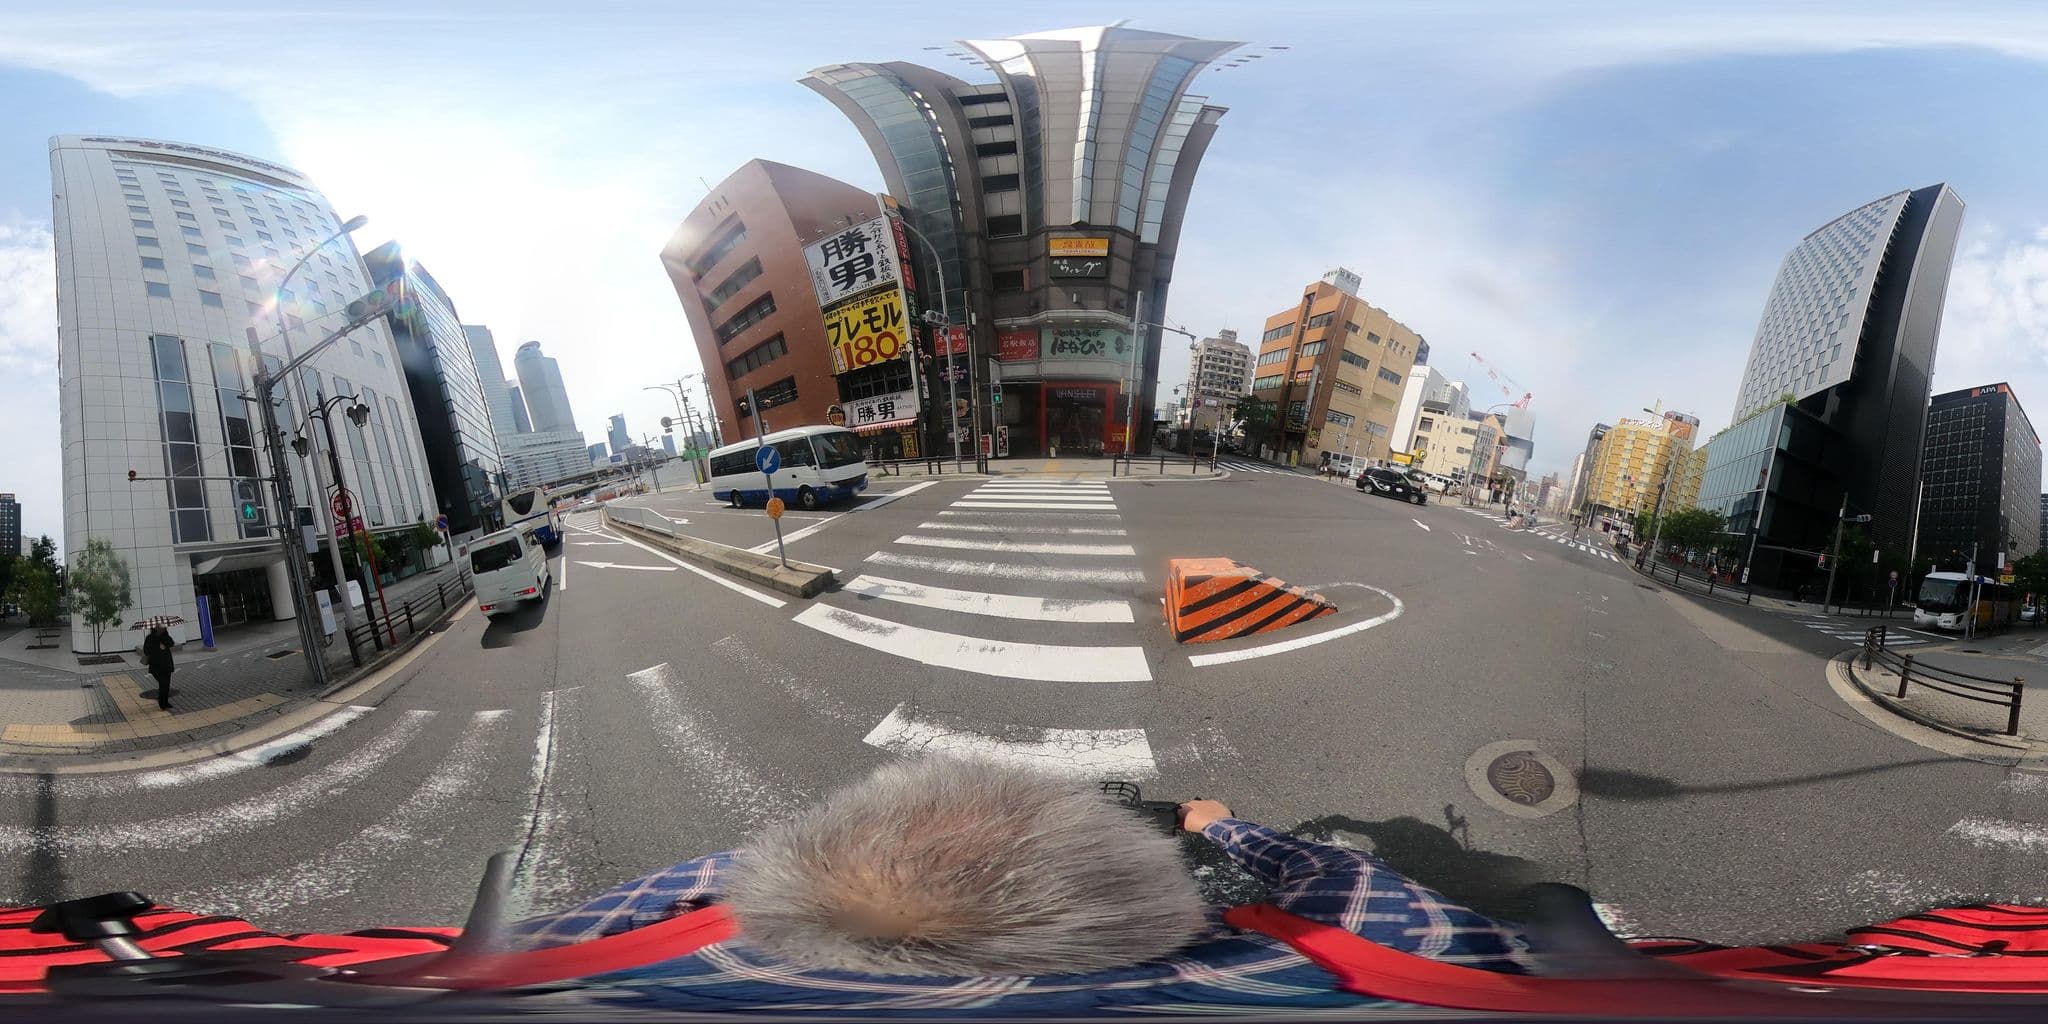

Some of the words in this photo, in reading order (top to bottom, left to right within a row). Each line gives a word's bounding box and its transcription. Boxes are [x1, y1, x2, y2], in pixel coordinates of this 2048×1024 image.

[821, 228, 877, 291] 勝男
[827, 302, 902, 347] プレモル
[843, 331, 899, 369] 180
[1050, 337, 1105, 355] はなび
[857, 401, 896, 422] 勝男
